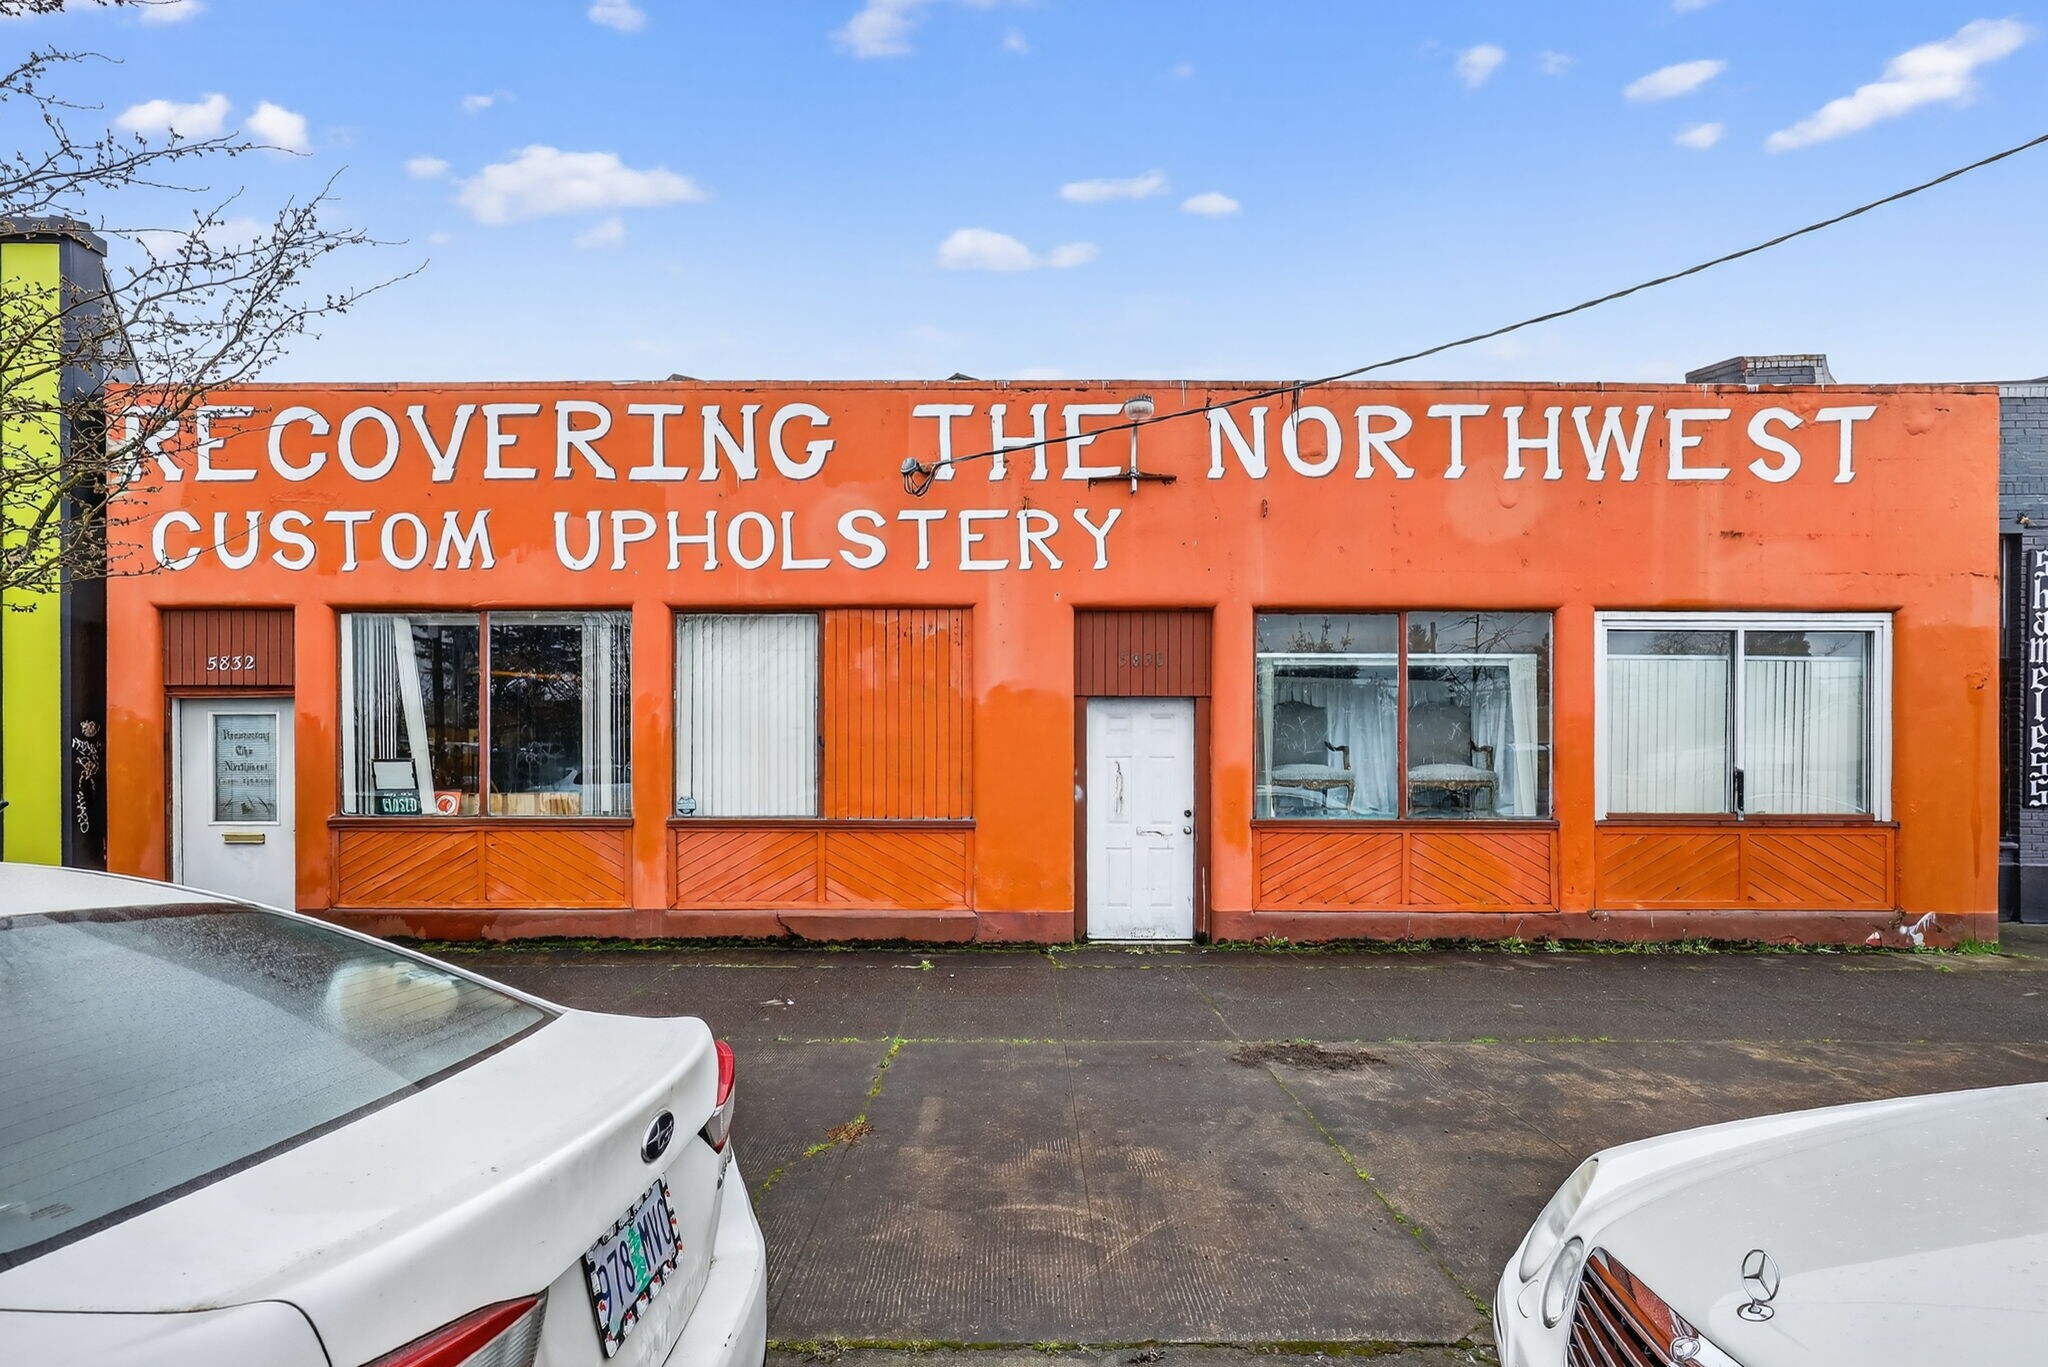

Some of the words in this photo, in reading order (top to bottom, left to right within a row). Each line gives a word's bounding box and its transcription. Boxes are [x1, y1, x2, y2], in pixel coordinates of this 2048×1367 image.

[111, 400, 836, 482] RECOVERING
[913, 403, 1128, 482] THE
[1206, 404, 1878, 484] NORTHWEST
[152, 509, 496, 572] CUSTOM
[553, 509, 1122, 571] UPHOLSTERY
[206, 655, 255, 671] 5832
